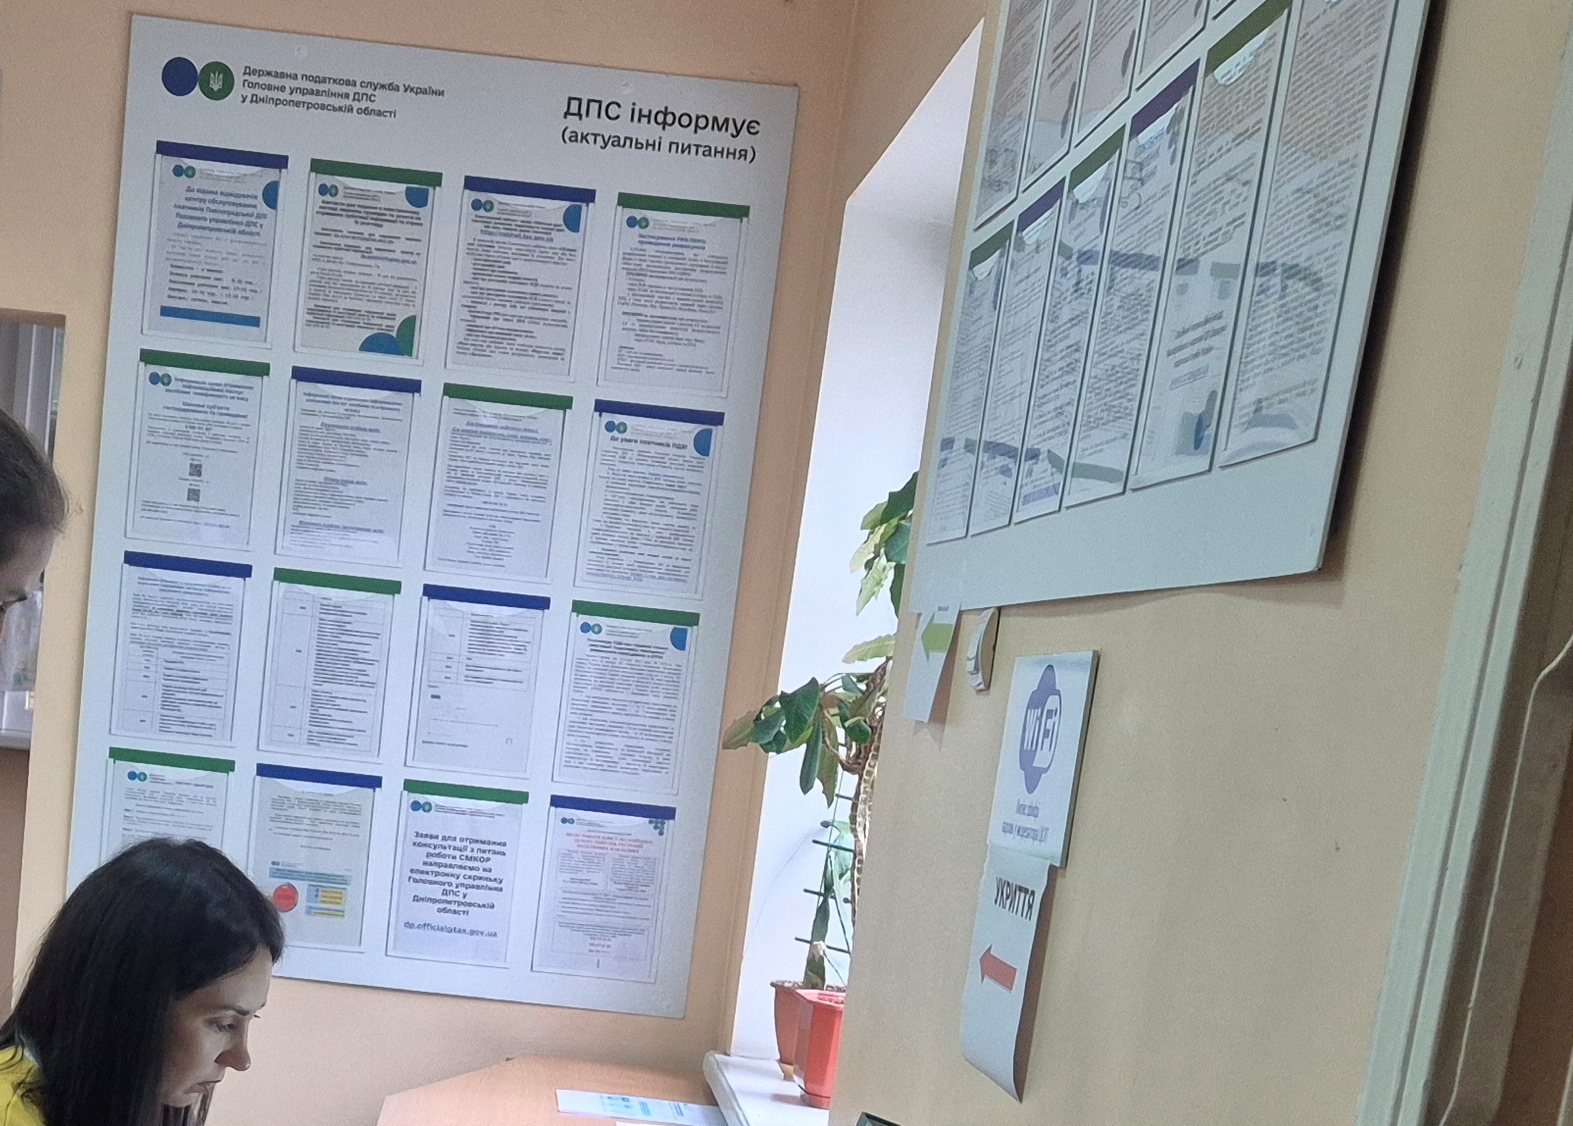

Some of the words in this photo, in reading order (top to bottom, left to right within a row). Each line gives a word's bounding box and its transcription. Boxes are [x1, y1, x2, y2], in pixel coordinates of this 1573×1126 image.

[243, 65, 298, 81] Державна
[301, 74, 357, 89] податкова
[359, 79, 400, 94] служба
[403, 83, 445, 97] України
[242, 80, 287, 93] Головне
[289, 85, 350, 101] управління
[352, 92, 377, 104] ДПС
[241, 94, 248, 104] у
[250, 93, 354, 115] Дніпропетровській
[356, 106, 397, 119] області
[563, 96, 622, 121] ДПС
[630, 102, 761, 139] інформує
[561, 126, 662, 152] (актуальні
[668, 140, 756, 164] питання)
[413, 831, 439, 840] Заяви
[459, 838, 506, 847] отримання
[412, 841, 467, 853] консультації
[476, 847, 506, 856] питань
[425, 852, 456, 860] роботи
[458, 854, 491, 863] СМКОР
[409, 868, 461, 880] електронну
[422, 861, 480, 872] направляємо
[407, 876, 453, 887] Головного
[454, 881, 503, 892] управління
[441, 889, 460, 897] ДПС
[994, 876, 1037, 922] УКРИТТЯ
[411, 895, 495, 909] Дніпропетровській
[436, 907, 469, 916] області
